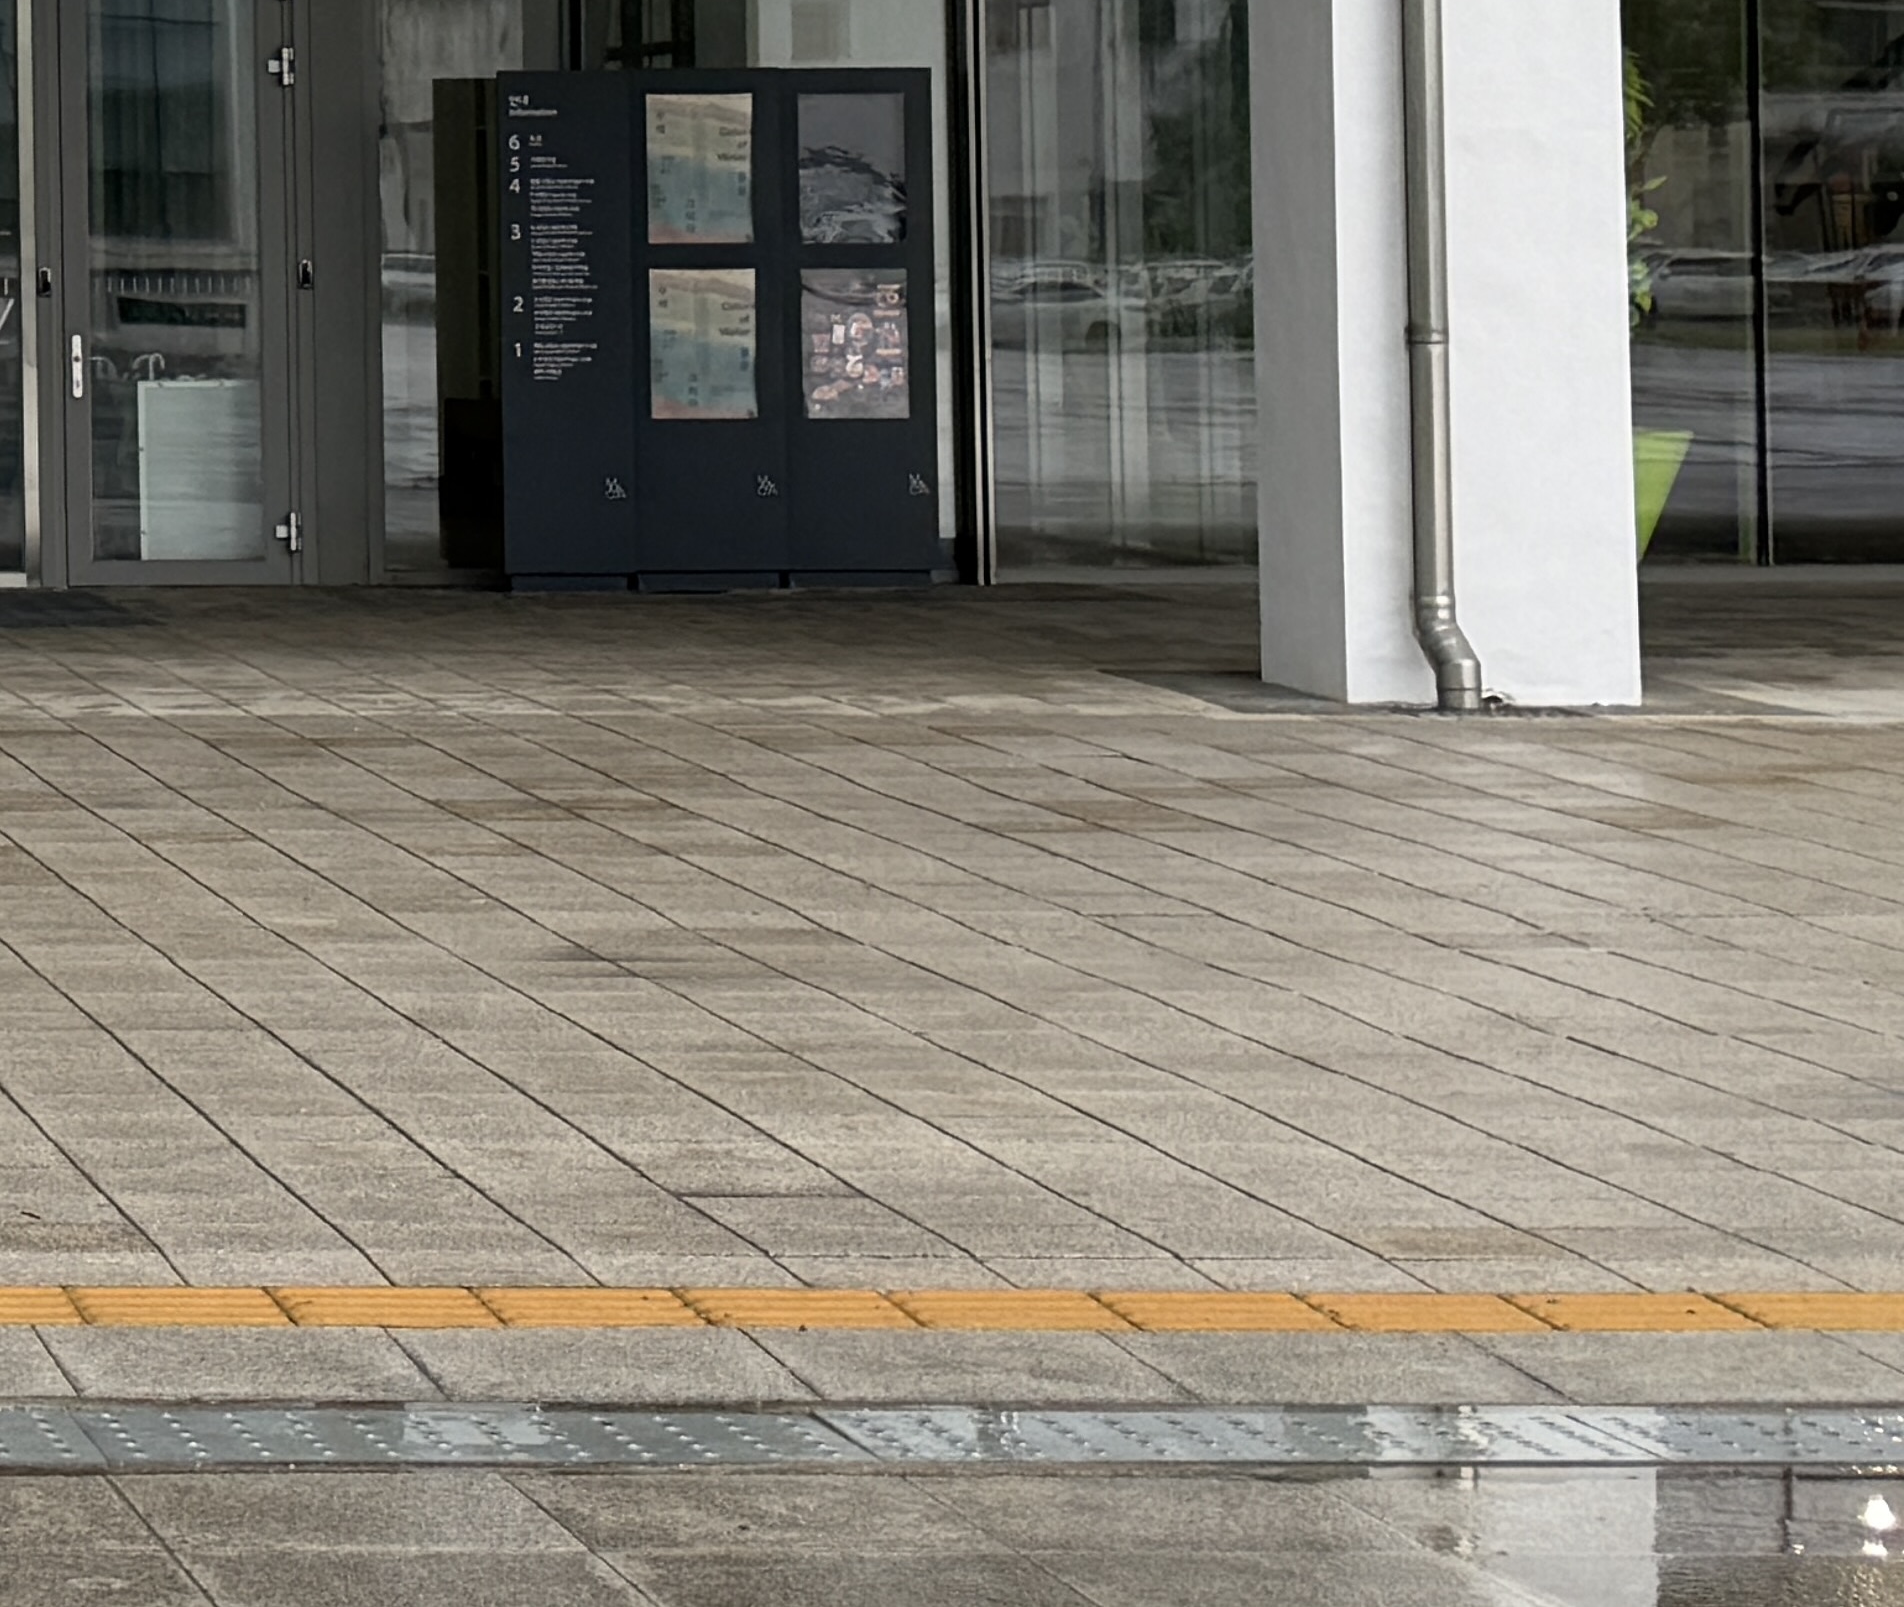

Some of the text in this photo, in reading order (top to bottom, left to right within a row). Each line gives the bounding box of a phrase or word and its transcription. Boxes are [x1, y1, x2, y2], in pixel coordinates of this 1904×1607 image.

[508, 134, 521, 151] 6
[509, 156, 520, 173] 5
[509, 178, 521, 194] 4
[510, 223, 522, 241] 3
[513, 295, 524, 313] 2
[514, 342, 522, 358] 1
